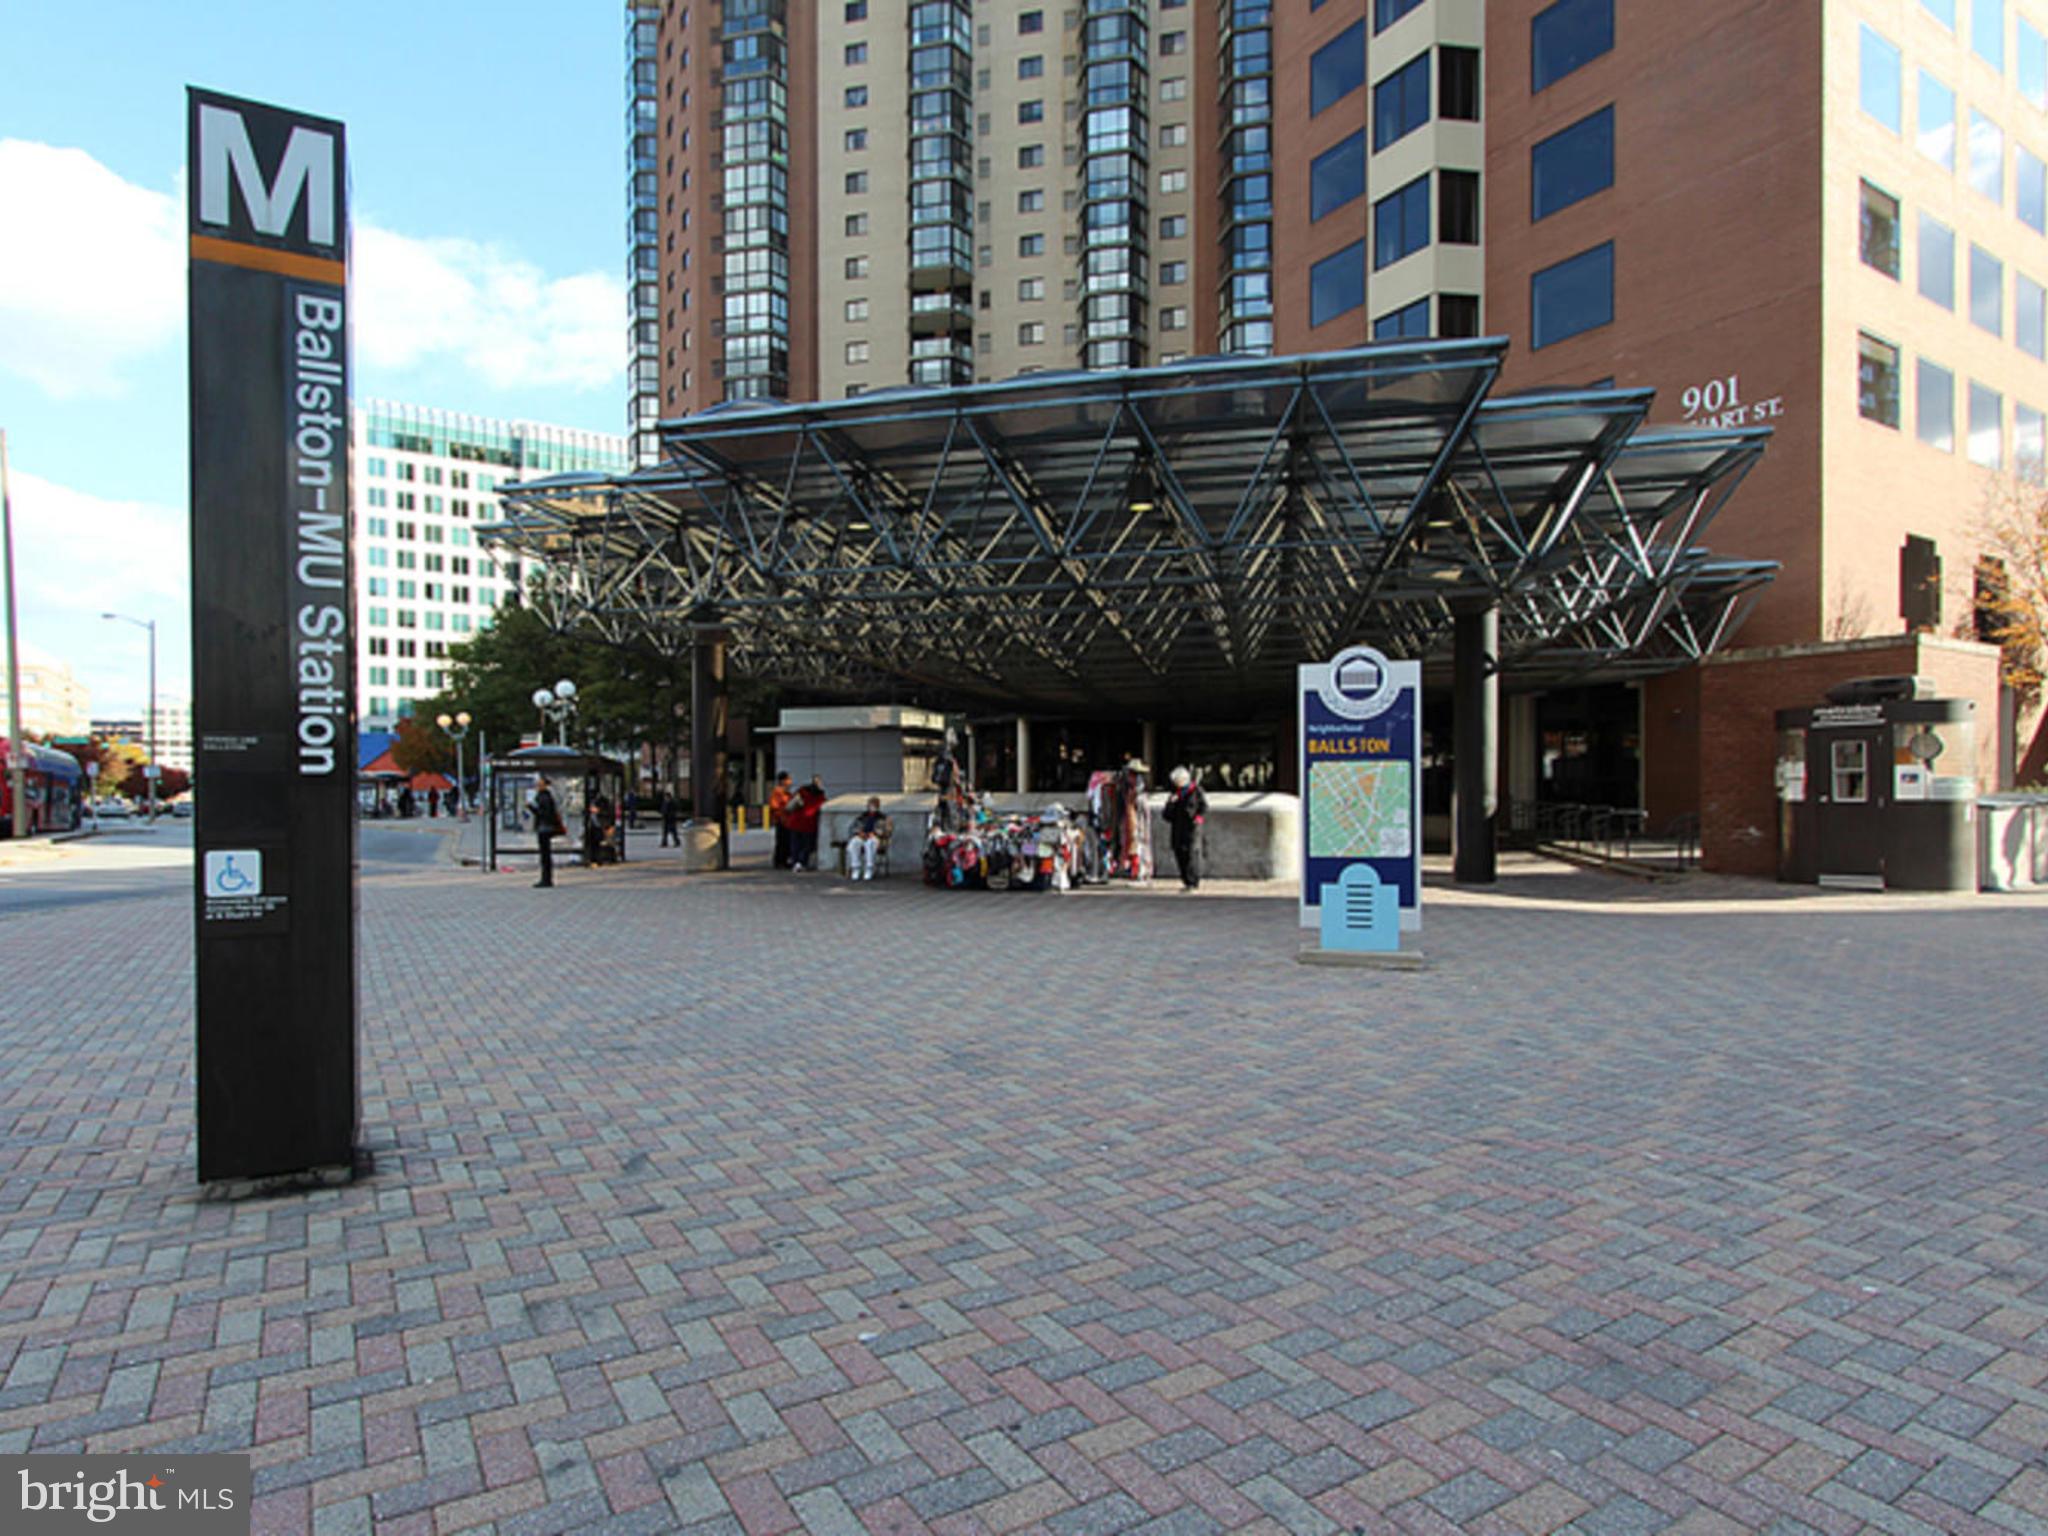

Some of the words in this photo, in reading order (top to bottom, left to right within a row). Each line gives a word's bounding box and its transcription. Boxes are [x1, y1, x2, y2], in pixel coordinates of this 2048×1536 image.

[199, 103, 335, 246] M
[296, 294, 344, 588] Ballston-MU
[1682, 375, 1738, 420] 901
[298, 604, 345, 774] Station
[1308, 738, 1390, 753] BALLSTON
